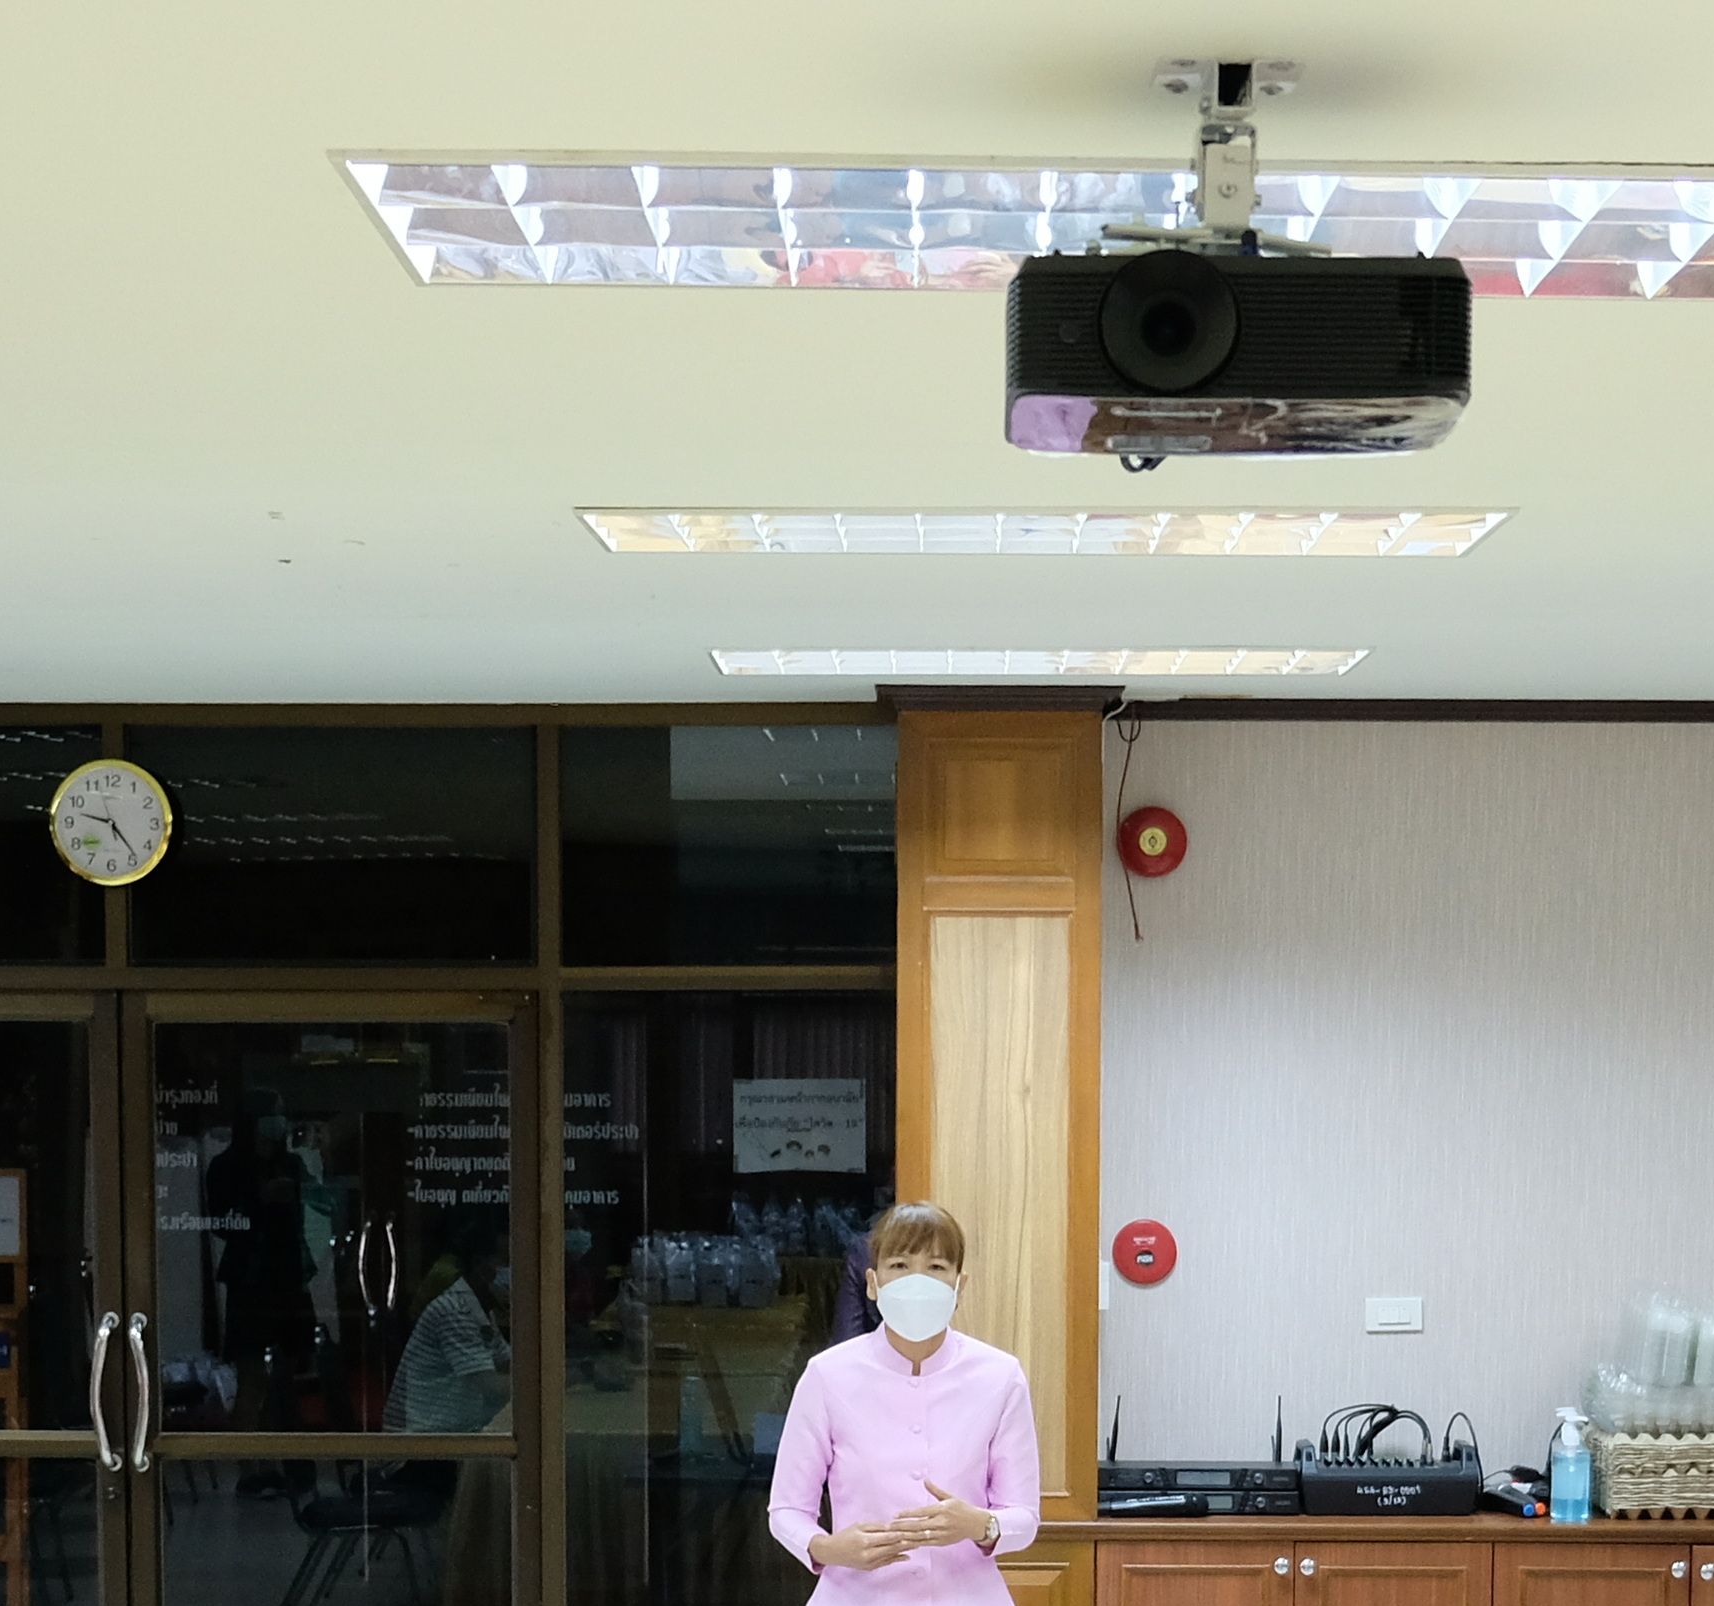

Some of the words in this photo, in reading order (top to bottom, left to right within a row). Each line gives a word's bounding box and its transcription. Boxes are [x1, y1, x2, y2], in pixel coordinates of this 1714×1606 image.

[85, 779, 99, 792] 11
[104, 774, 121, 788] 12
[130, 781, 137, 793] 1
[69, 795, 85, 809] 10
[143, 796, 153, 809] 2
[64, 816, 74, 829] 9
[149, 818, 160, 831] 3
[71, 837, 81, 851] 8
[143, 839, 152, 851] 4
[87, 852, 96, 865] 7
[128, 854, 137, 867] 5
[107, 859, 117, 872] 6
